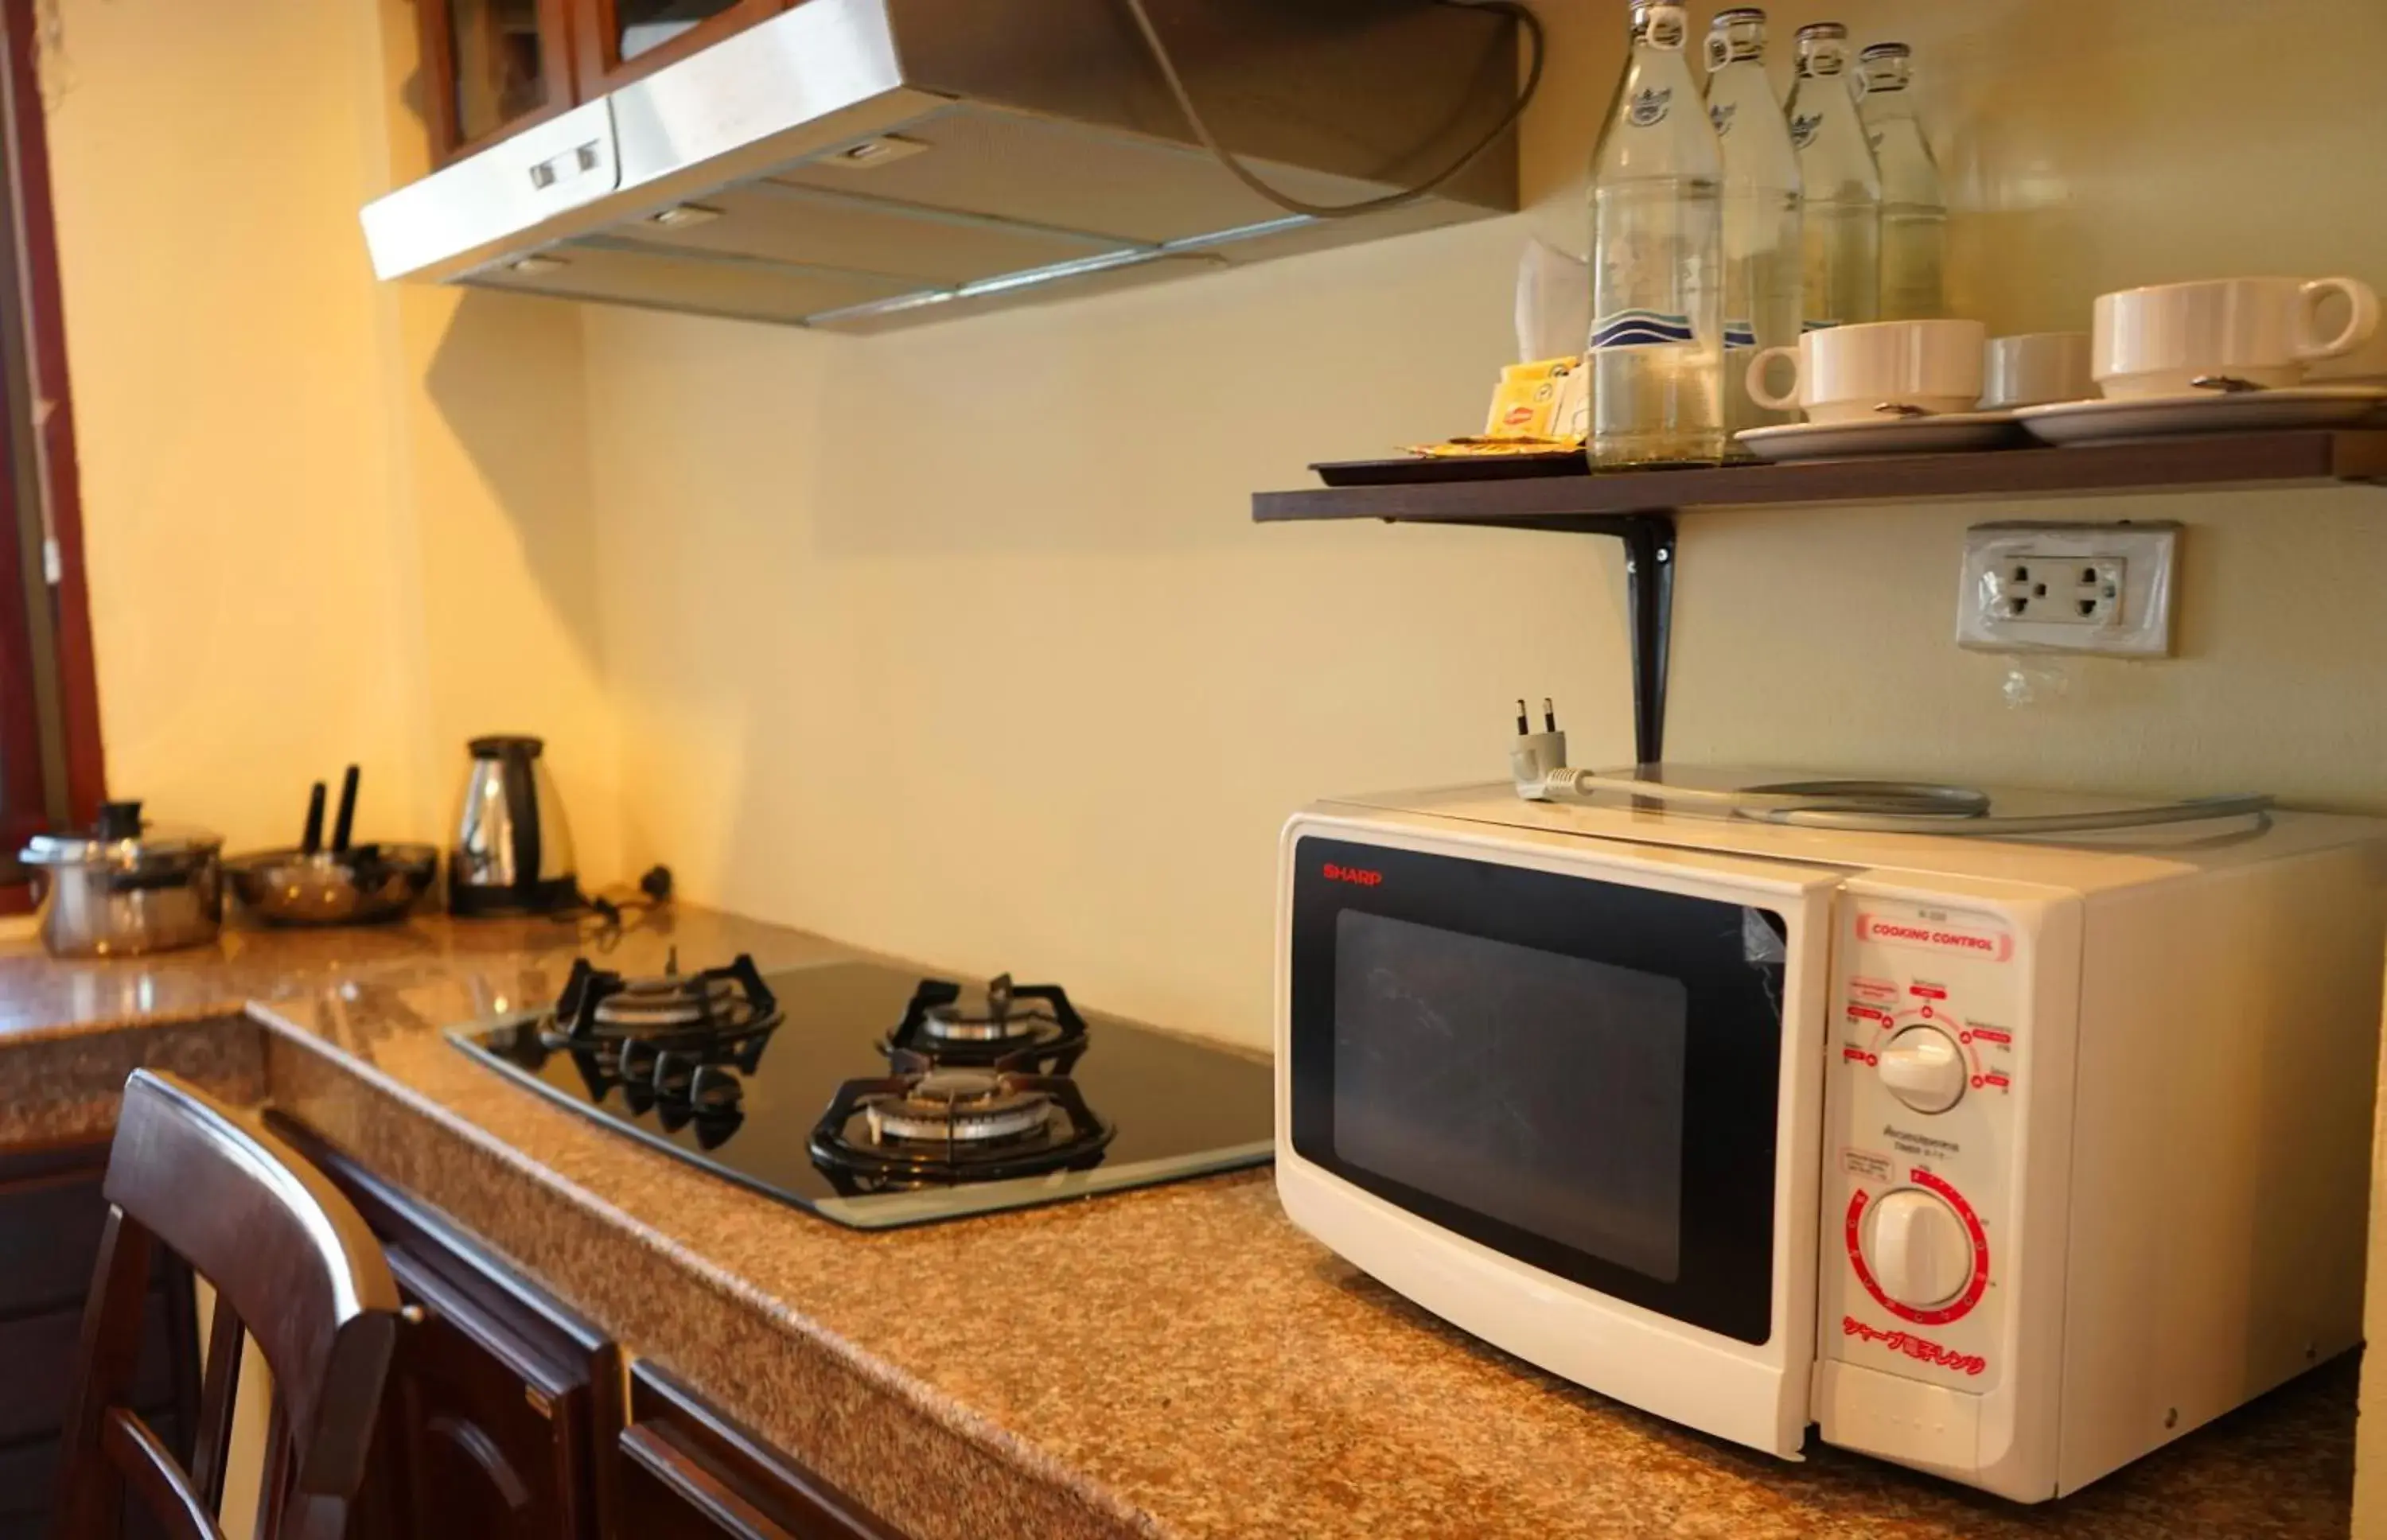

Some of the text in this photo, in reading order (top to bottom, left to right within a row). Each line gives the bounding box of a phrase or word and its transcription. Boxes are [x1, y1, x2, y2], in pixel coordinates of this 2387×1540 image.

[1322, 863, 1383, 885] SHARP
[1872, 923, 1993, 952] COOKING CONTROL
